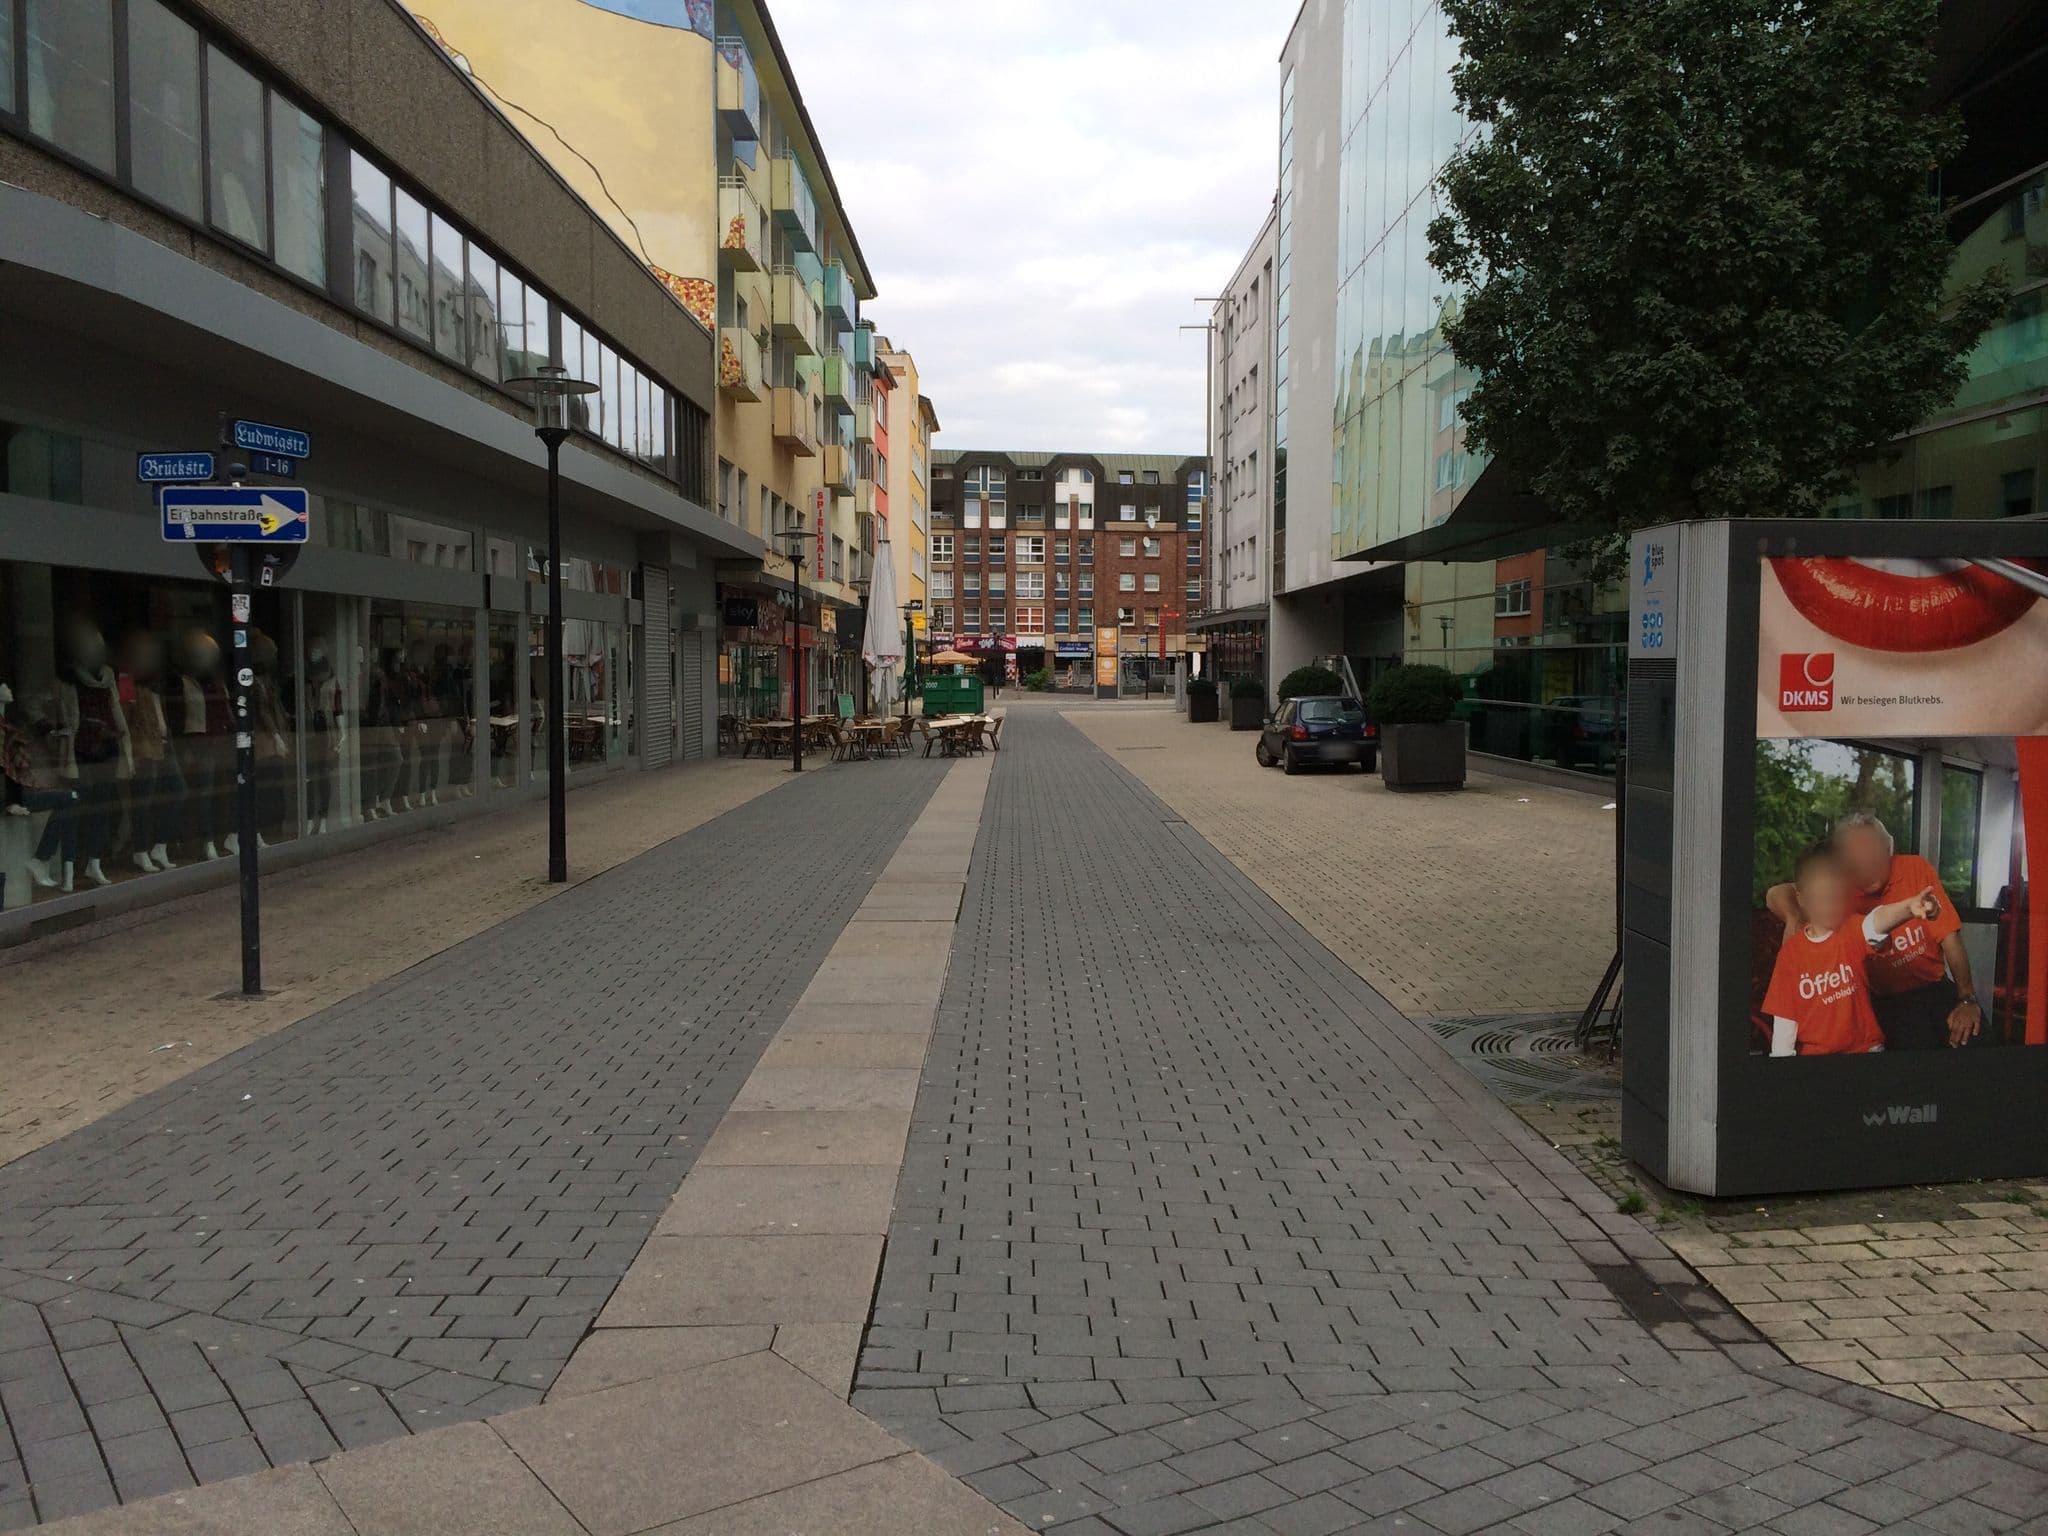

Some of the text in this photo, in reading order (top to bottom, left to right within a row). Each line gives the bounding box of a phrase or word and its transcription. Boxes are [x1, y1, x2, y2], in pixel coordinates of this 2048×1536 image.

[237, 424, 307, 453] Ludwigstr.
[144, 459, 208, 477] Brückstr.
[265, 457, 289, 474] 1-16
[170, 508, 264, 521] Eibahnstraße
[1652, 543, 1664, 556] blue
[1651, 556, 1664, 569] spot
[727, 605, 754, 620] sky
[1783, 690, 1829, 706] DKMS
[1840, 694, 1944, 707] Wir besiegen Blutkrebs.
[1887, 1103, 1938, 1124] Wall
